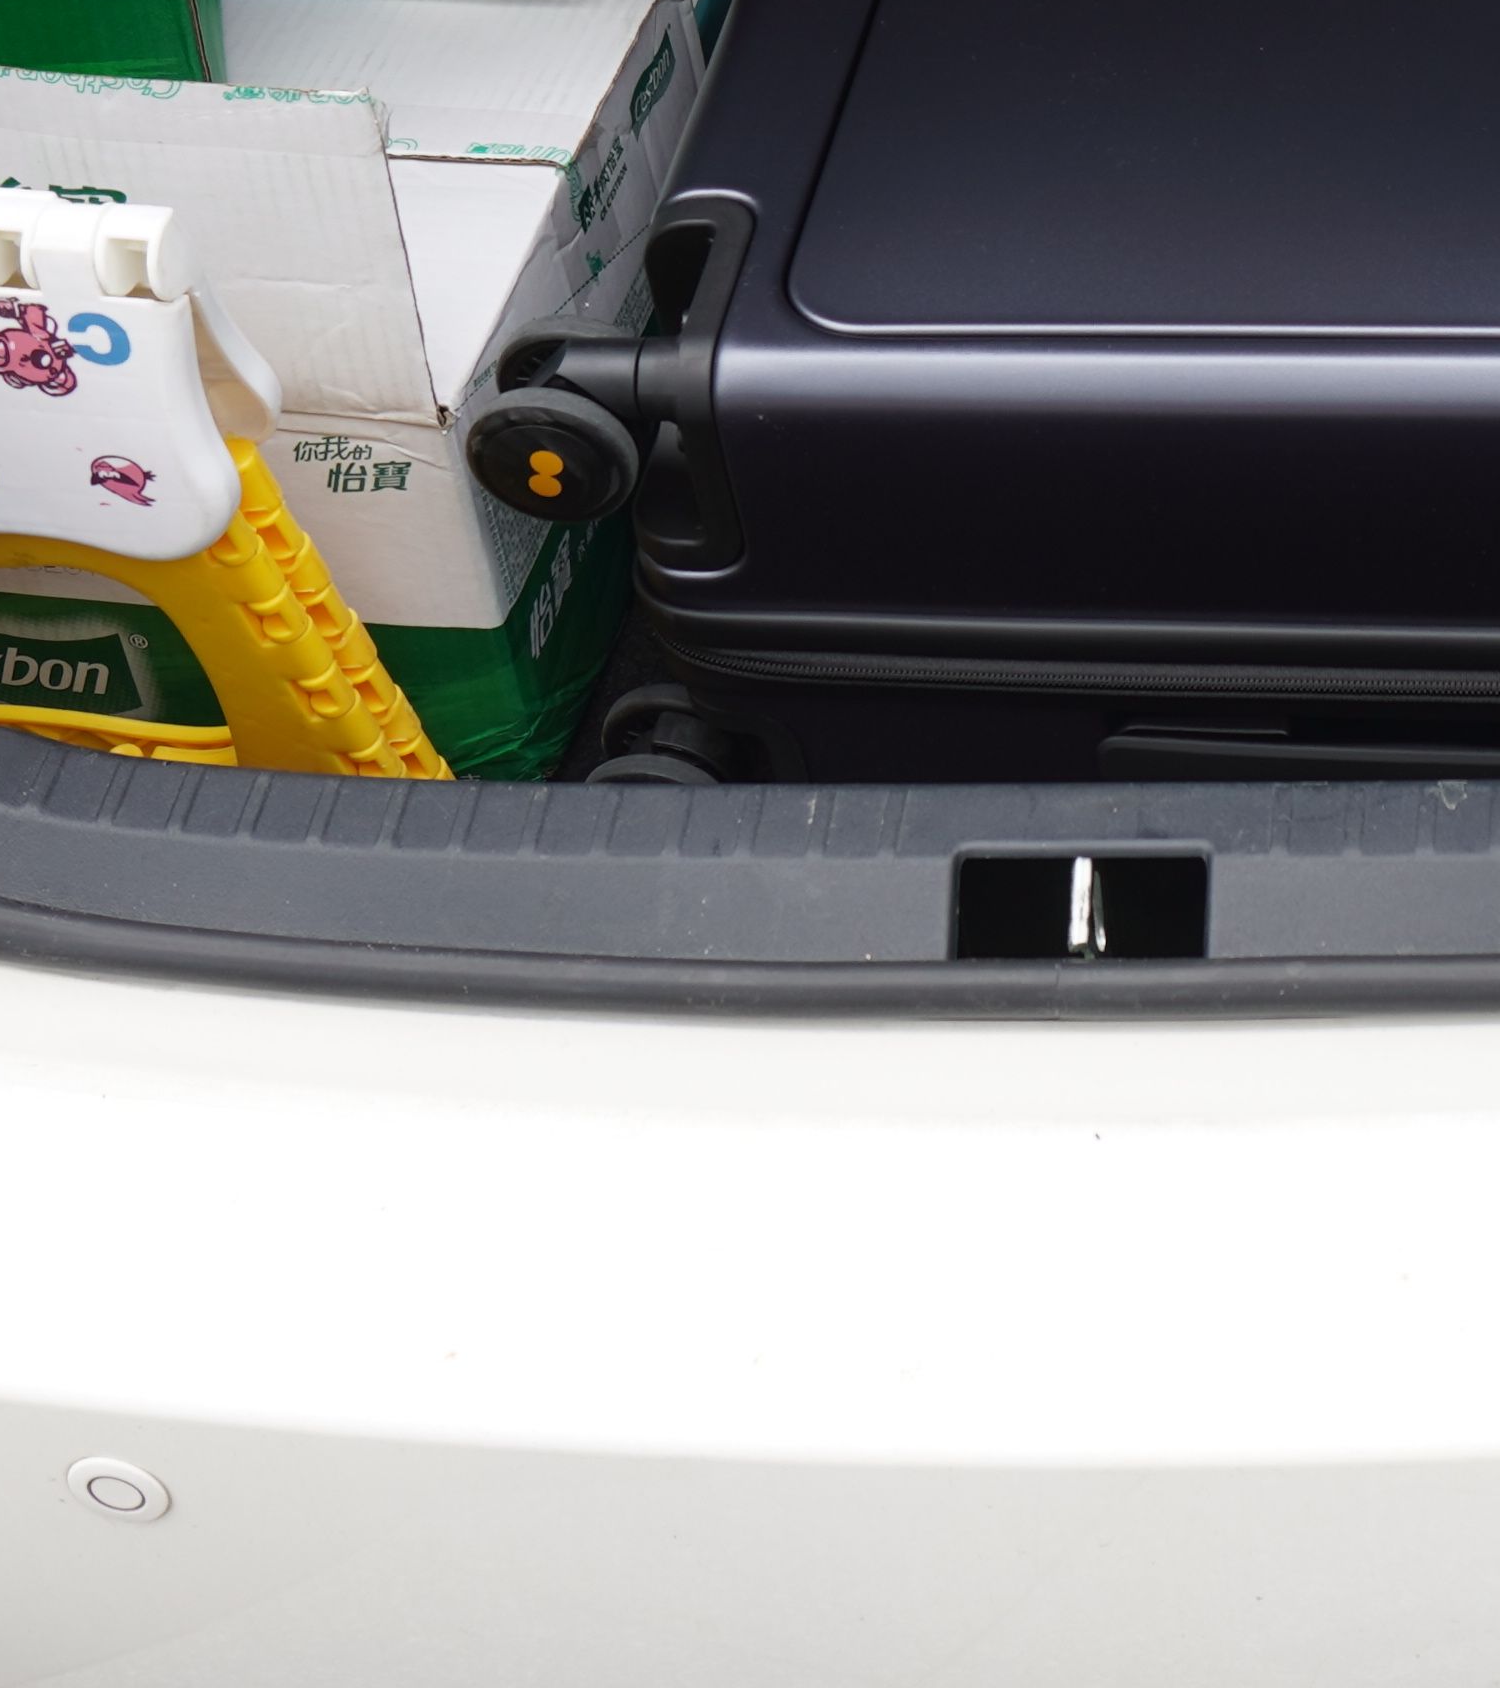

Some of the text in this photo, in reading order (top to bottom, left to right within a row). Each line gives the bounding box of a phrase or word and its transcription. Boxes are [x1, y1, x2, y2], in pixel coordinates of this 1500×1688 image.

[68, 312, 131, 367] C
[292, 435, 373, 463] 你我的
